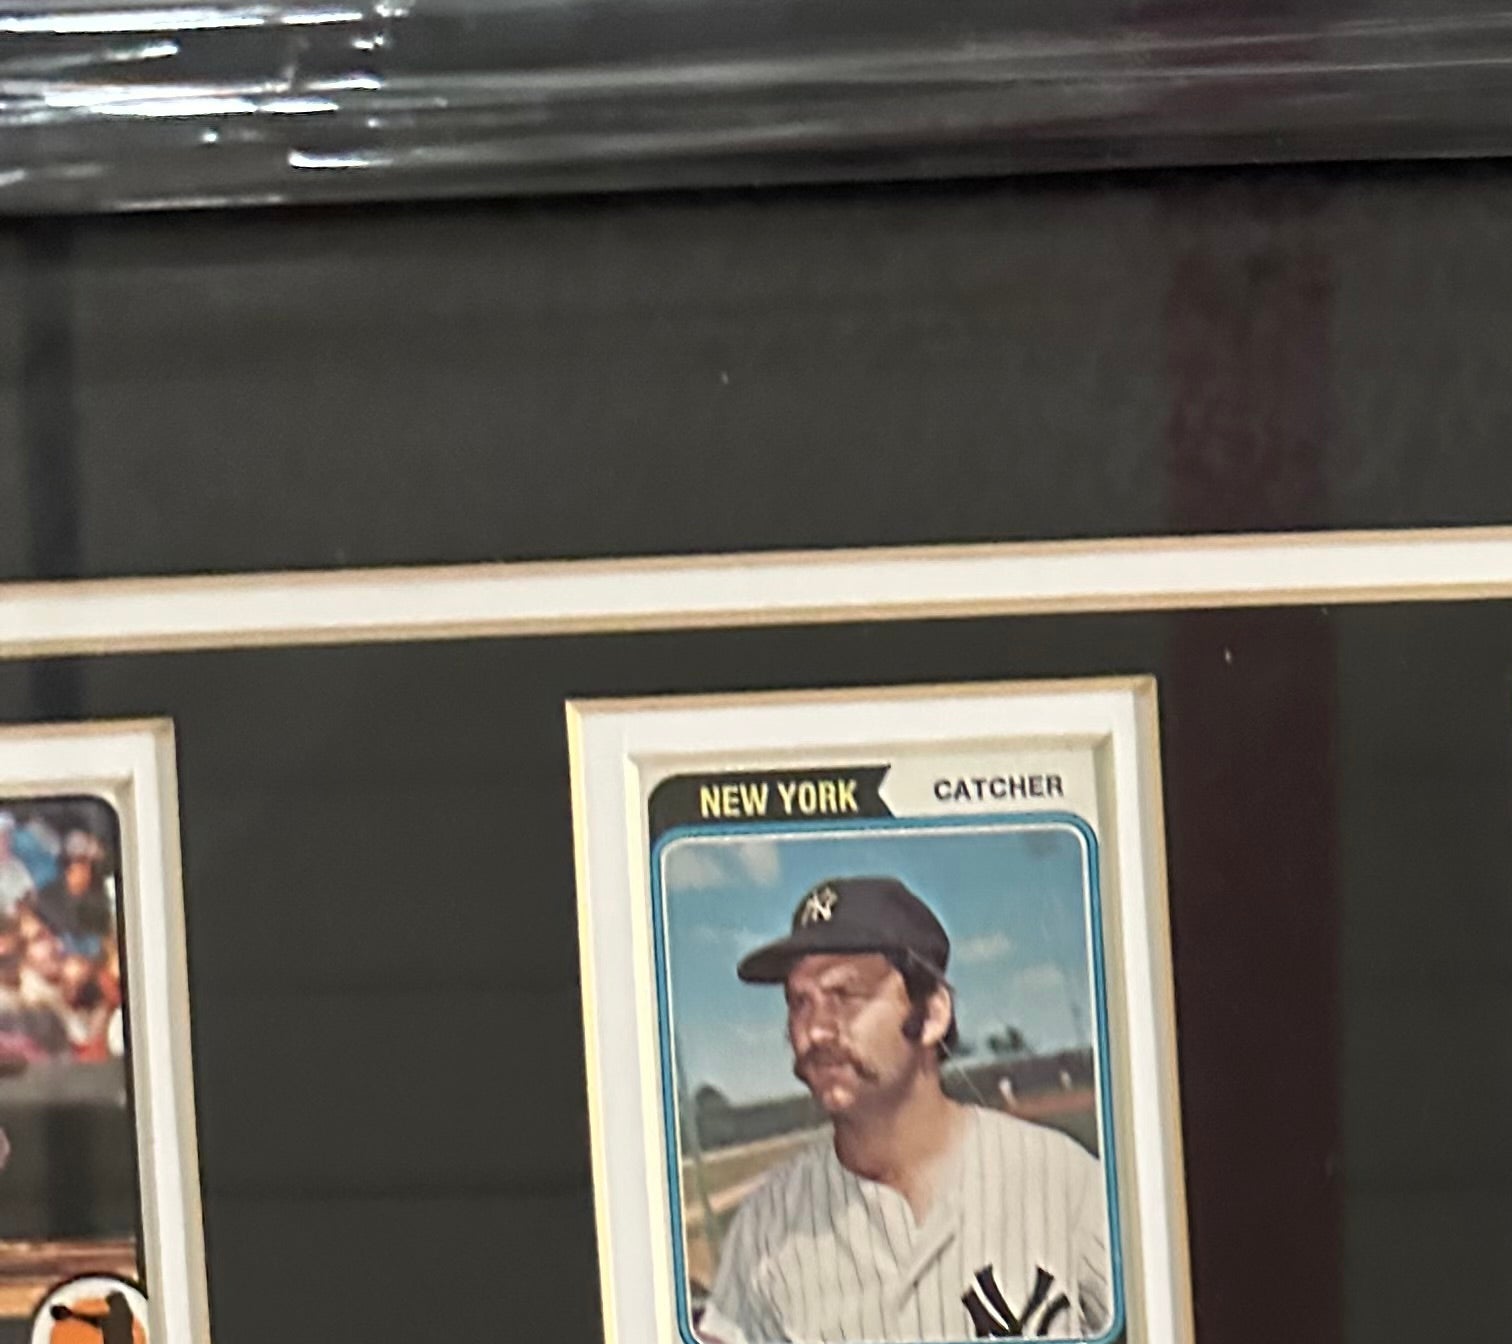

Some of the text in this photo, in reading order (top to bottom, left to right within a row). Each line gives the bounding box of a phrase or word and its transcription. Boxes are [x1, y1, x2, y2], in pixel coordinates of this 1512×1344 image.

[700, 779, 859, 818] NEW YORK
[933, 774, 1064, 802] CATCHER
